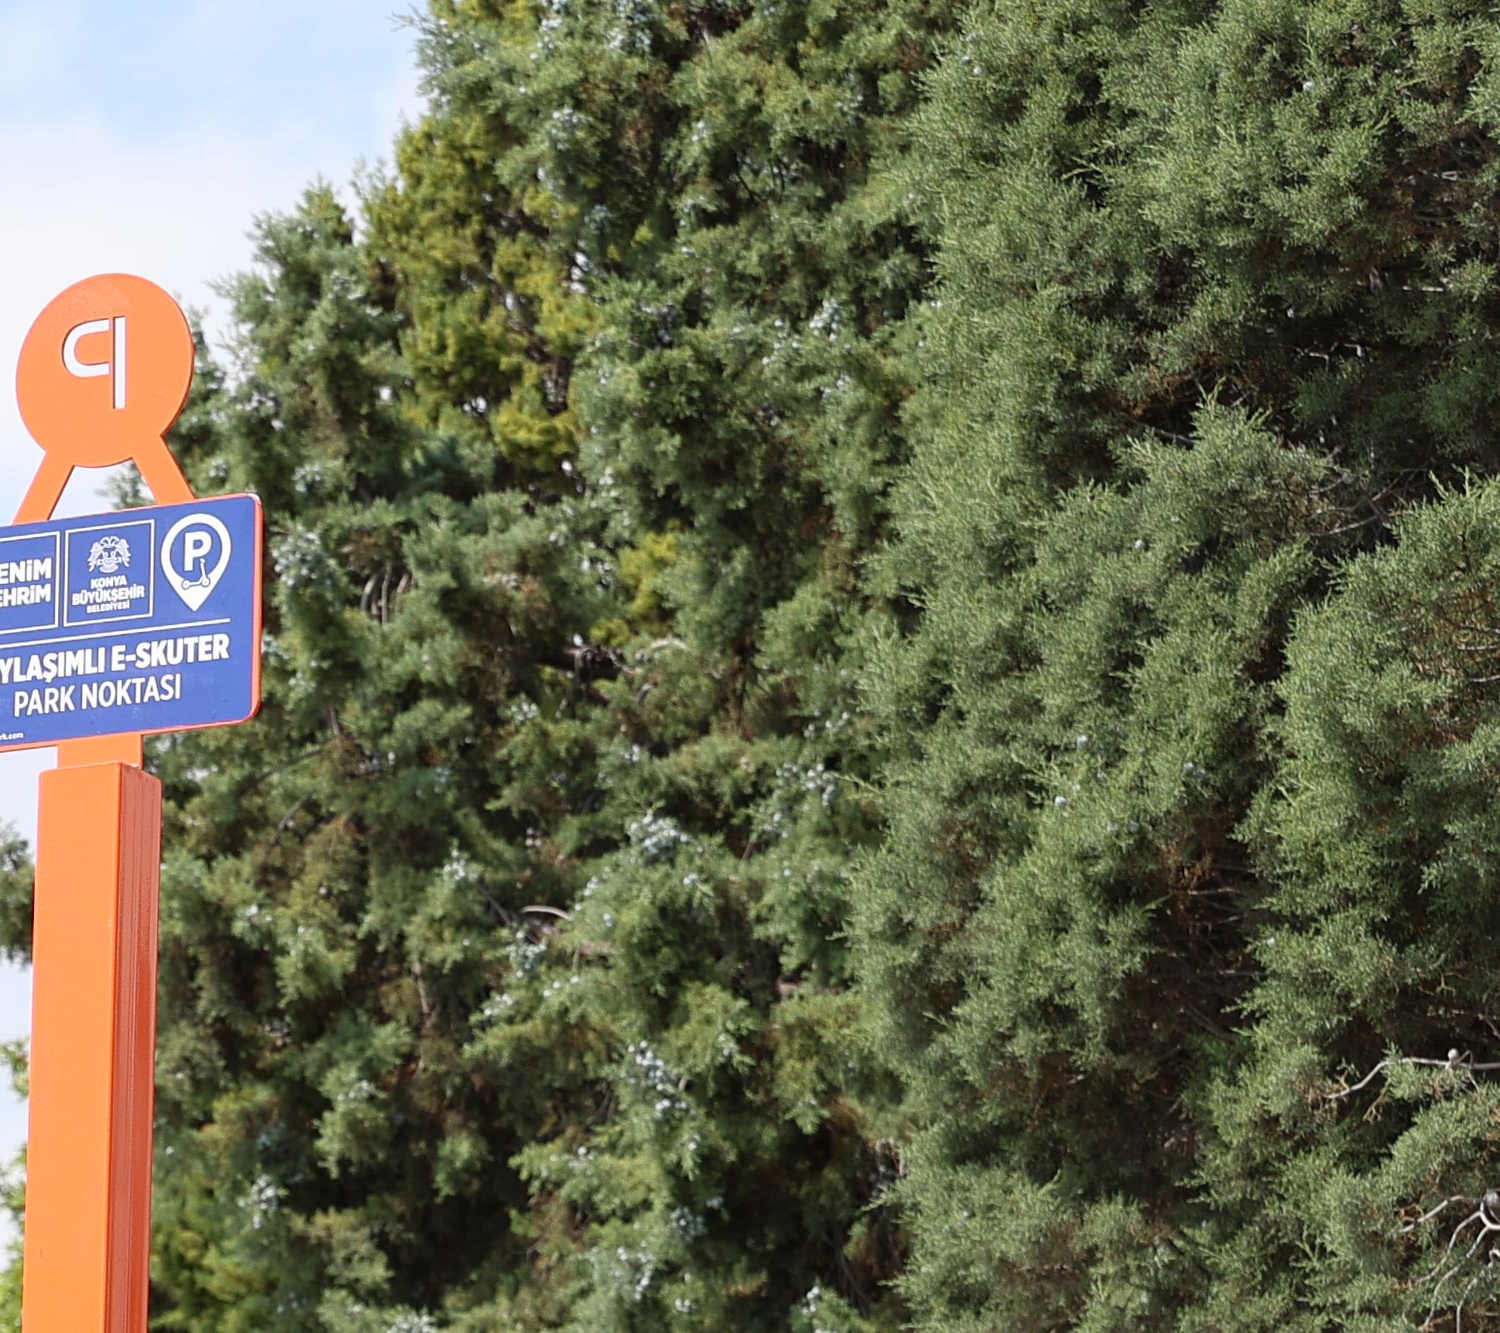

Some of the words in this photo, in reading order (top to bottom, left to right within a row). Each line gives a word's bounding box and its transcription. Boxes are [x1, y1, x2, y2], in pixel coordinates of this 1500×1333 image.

[90, 575, 127, 590] KONYA
[72, 584, 145, 606] BÜYÜKŞEHİR
[86, 600, 130, 613] BELEDİYESİ
[110, 633, 230, 671] E-SKUTER
[13, 686, 75, 717] PARK
[81, 673, 181, 710] NOKTASI
